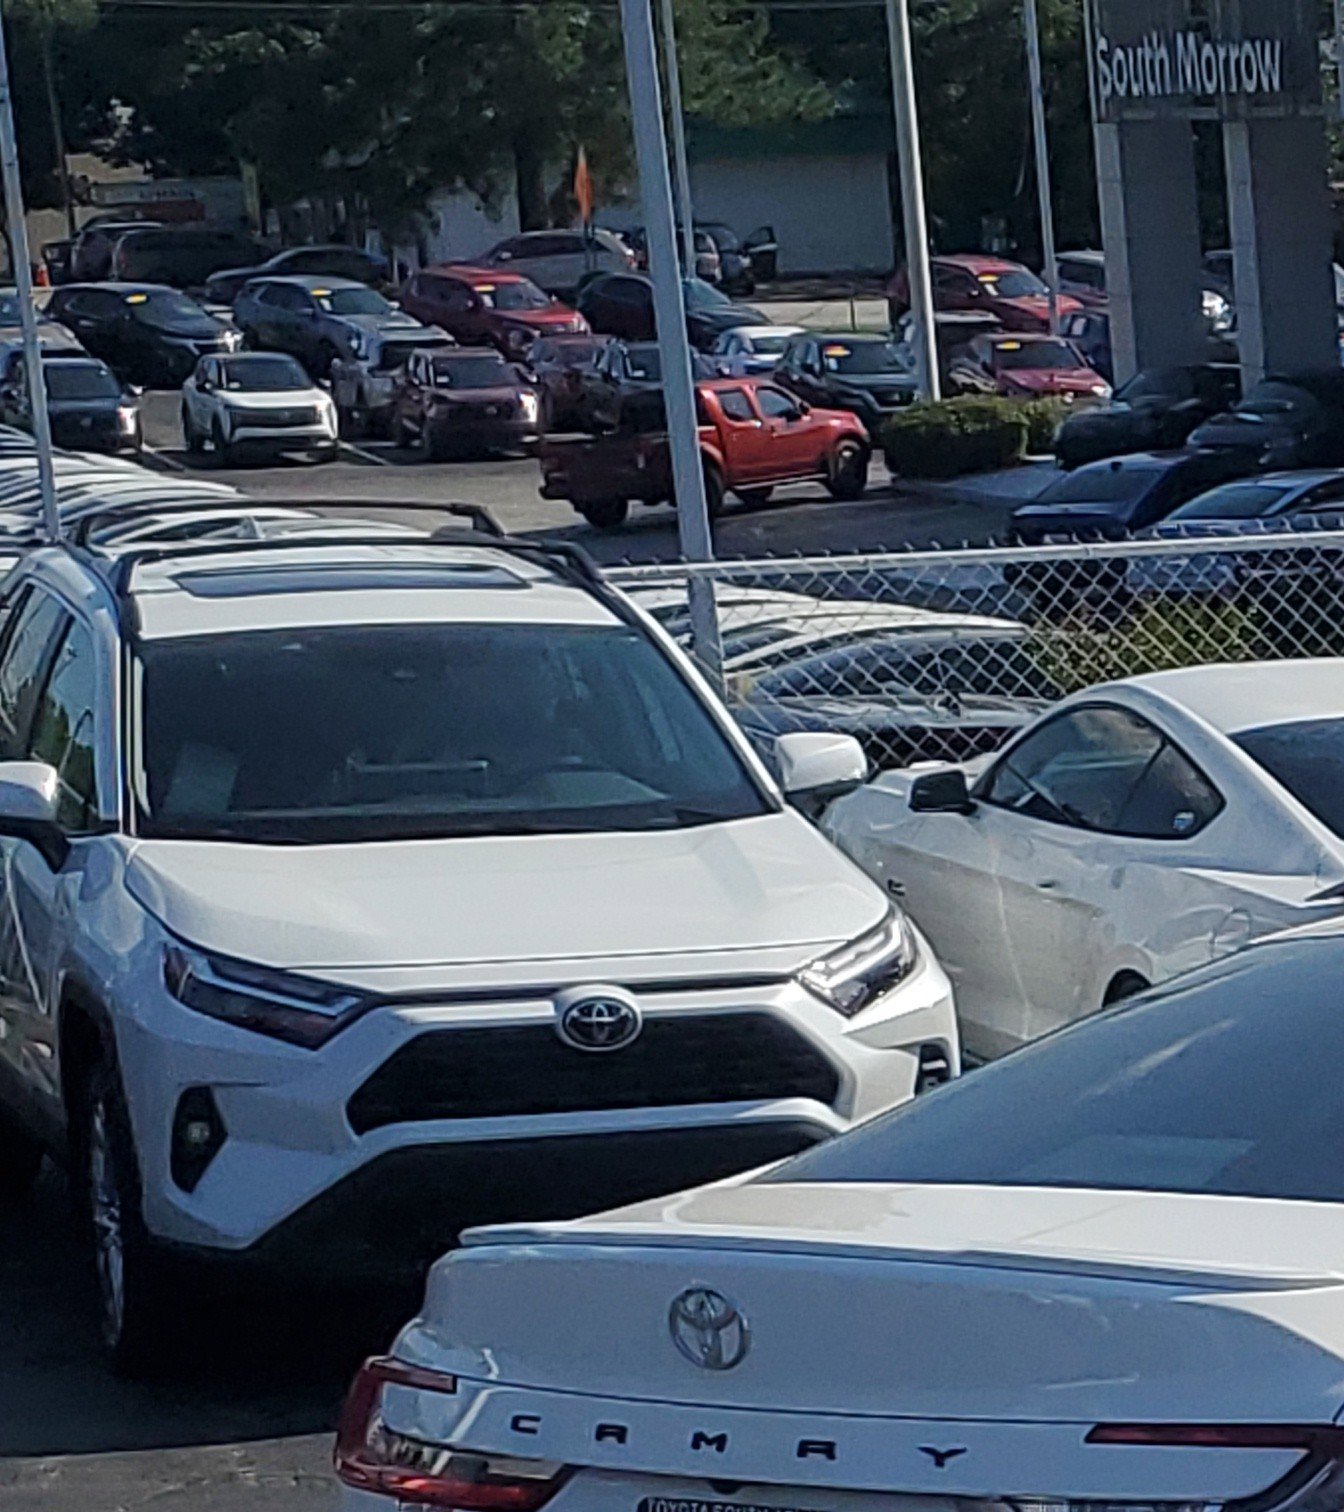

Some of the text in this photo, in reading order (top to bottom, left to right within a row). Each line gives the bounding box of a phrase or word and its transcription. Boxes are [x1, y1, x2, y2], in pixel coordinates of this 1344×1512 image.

[1097, 31, 1282, 97] South Morrow
[510, 1413, 967, 1468] CAMRY
